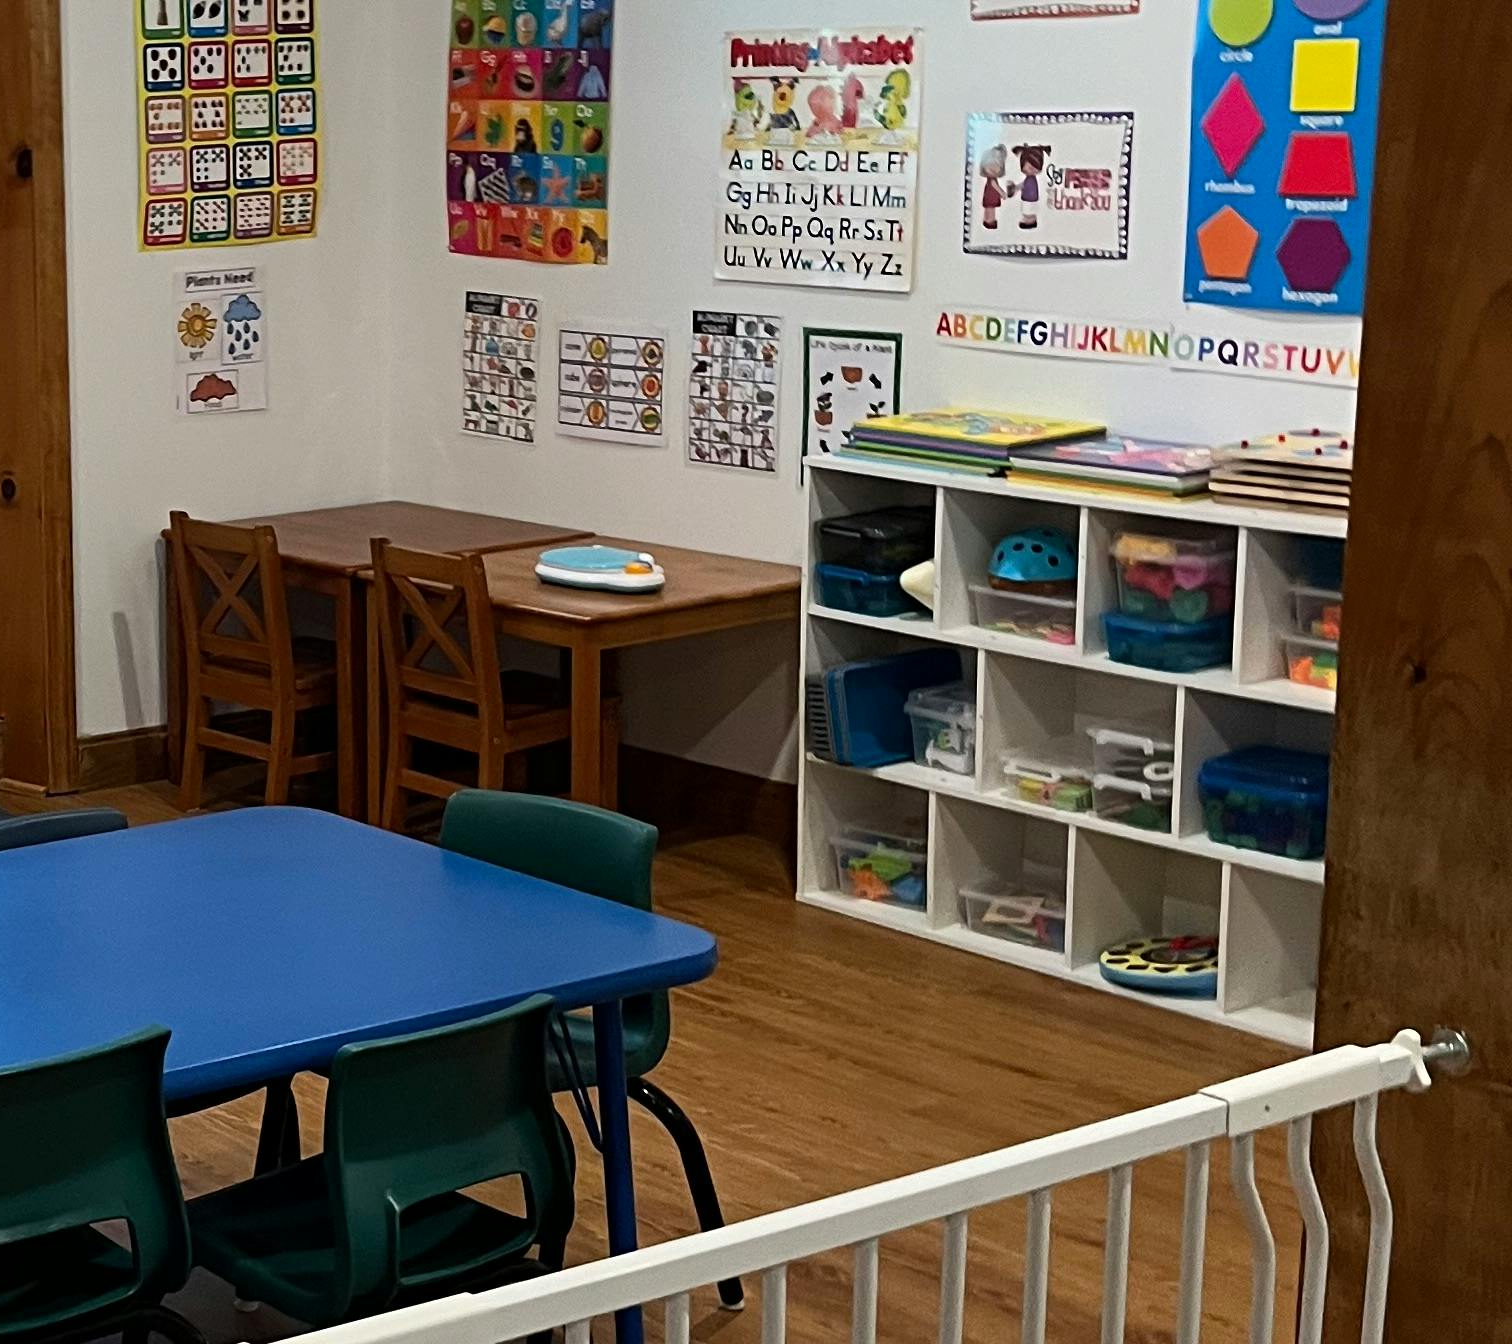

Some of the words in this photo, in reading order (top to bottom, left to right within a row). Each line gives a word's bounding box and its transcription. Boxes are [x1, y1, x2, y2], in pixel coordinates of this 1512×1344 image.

[729, 149, 753, 171] Aa
[762, 149, 784, 171] Bb
[792, 150, 816, 172] Cc
[825, 150, 849, 172] Dd
[857, 151, 879, 173] Ee
[888, 152, 908, 173] Ff
[726, 181, 752, 210] Gg
[756, 182, 779, 204] Hh
[784, 182, 796, 204] Ii
[801, 183, 818, 212] Jj
[823, 184, 845, 206] Kk
[850, 185, 867, 206] Ll
[872, 185, 906, 208] Mm
[725, 214, 748, 235] Nn
[751, 214, 777, 236] Oo
[781, 215, 802, 244] Pp
[807, 217, 834, 245] Qq
[839, 217, 860, 240] Rr
[864, 219, 883, 241] Ss
[885, 220, 904, 242] Tt
[723, 245, 746, 267] Uu
[753, 247, 772, 268] Vv
[779, 248, 813, 270] Ww
[821, 250, 846, 272] Xx
[851, 252, 873, 280] Yy
[880, 253, 903, 276] Zz
